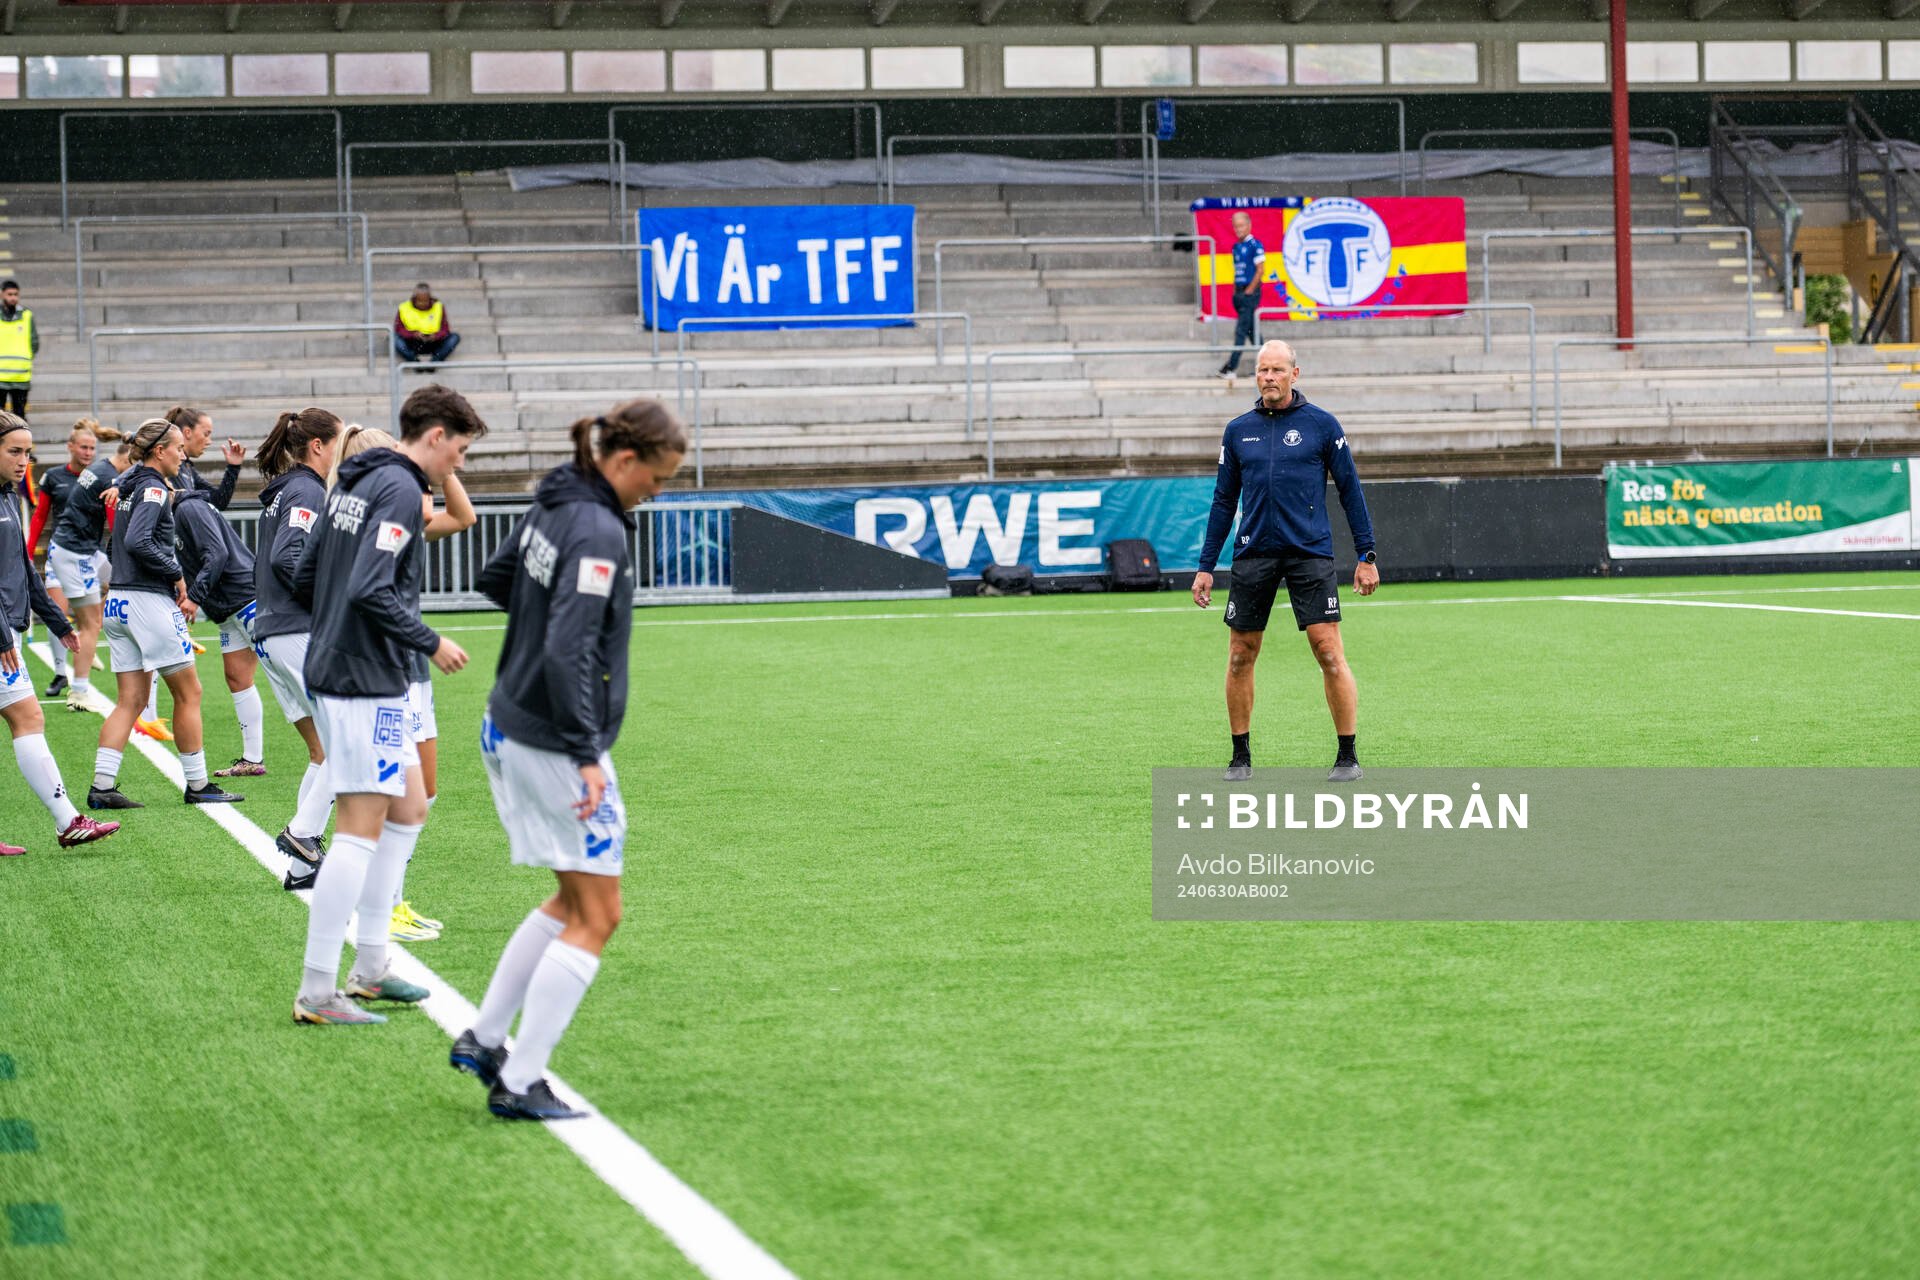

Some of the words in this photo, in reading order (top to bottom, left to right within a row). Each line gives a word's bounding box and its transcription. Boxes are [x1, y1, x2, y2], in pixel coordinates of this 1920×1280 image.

[651, 231, 699, 302] Vi
[717, 223, 782, 304] Är
[797, 235, 901, 304] TFF
[1303, 222, 1370, 289] T
[1306, 250, 1318, 274] F
[1357, 248, 1369, 272] F
[1622, 480, 1667, 502] Res
[1671, 479, 1705, 500] för
[1623, 506, 1690, 527] nästa
[1695, 501, 1823, 529] generation
[854, 490, 1102, 570] RWE
[1241, 535, 1250, 545] RP
